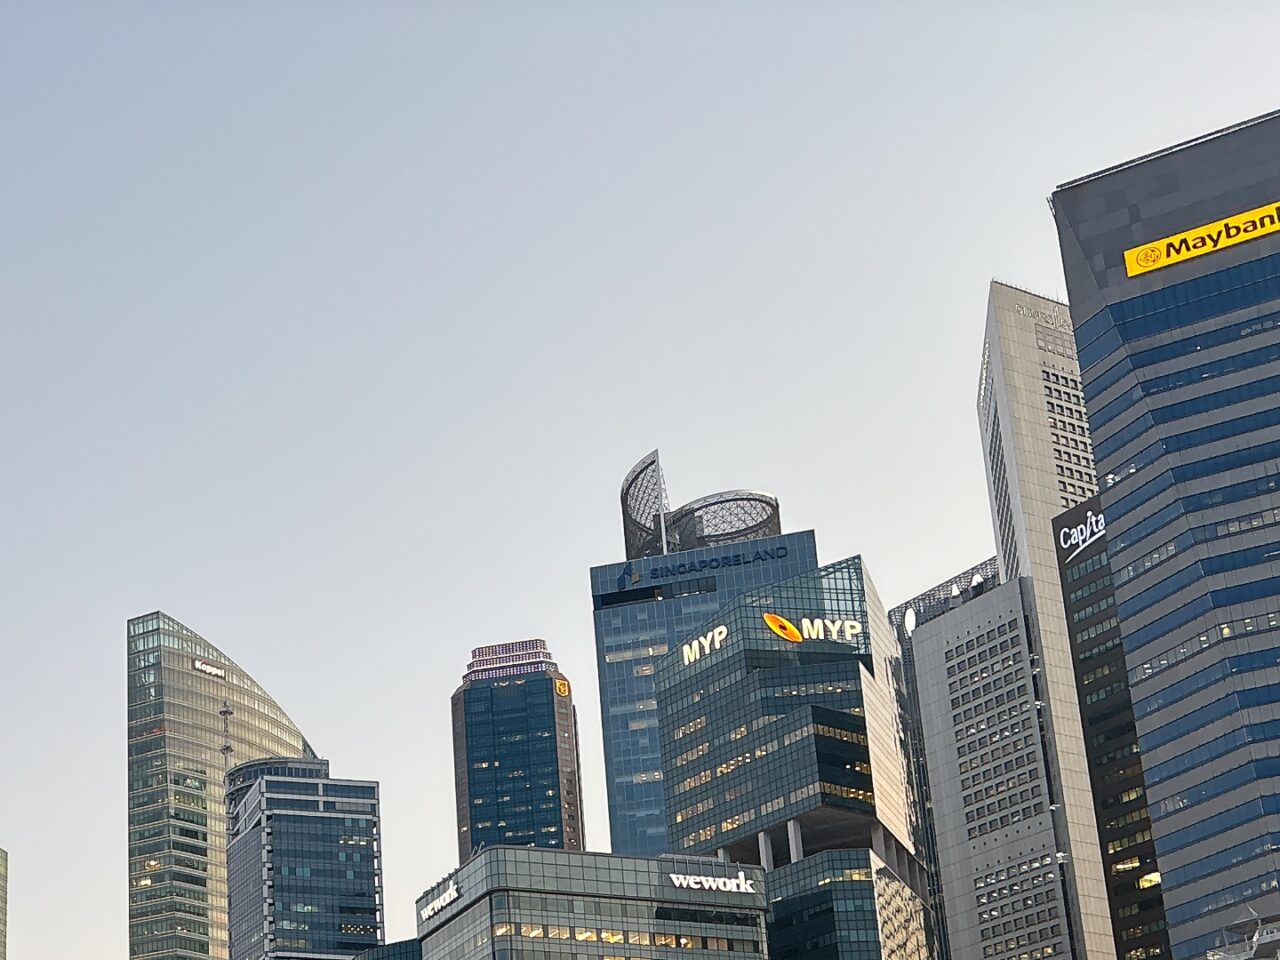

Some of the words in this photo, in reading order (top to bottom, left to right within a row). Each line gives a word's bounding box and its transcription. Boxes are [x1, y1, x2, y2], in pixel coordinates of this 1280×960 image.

[1060, 511, 1105, 549] Capita
[650, 547, 788, 579] SINGAPORELAND
[683, 625, 728, 665] MYP
[801, 618, 862, 640] MYP
[669, 871, 756, 893] wework
[420, 880, 459, 921] wework
